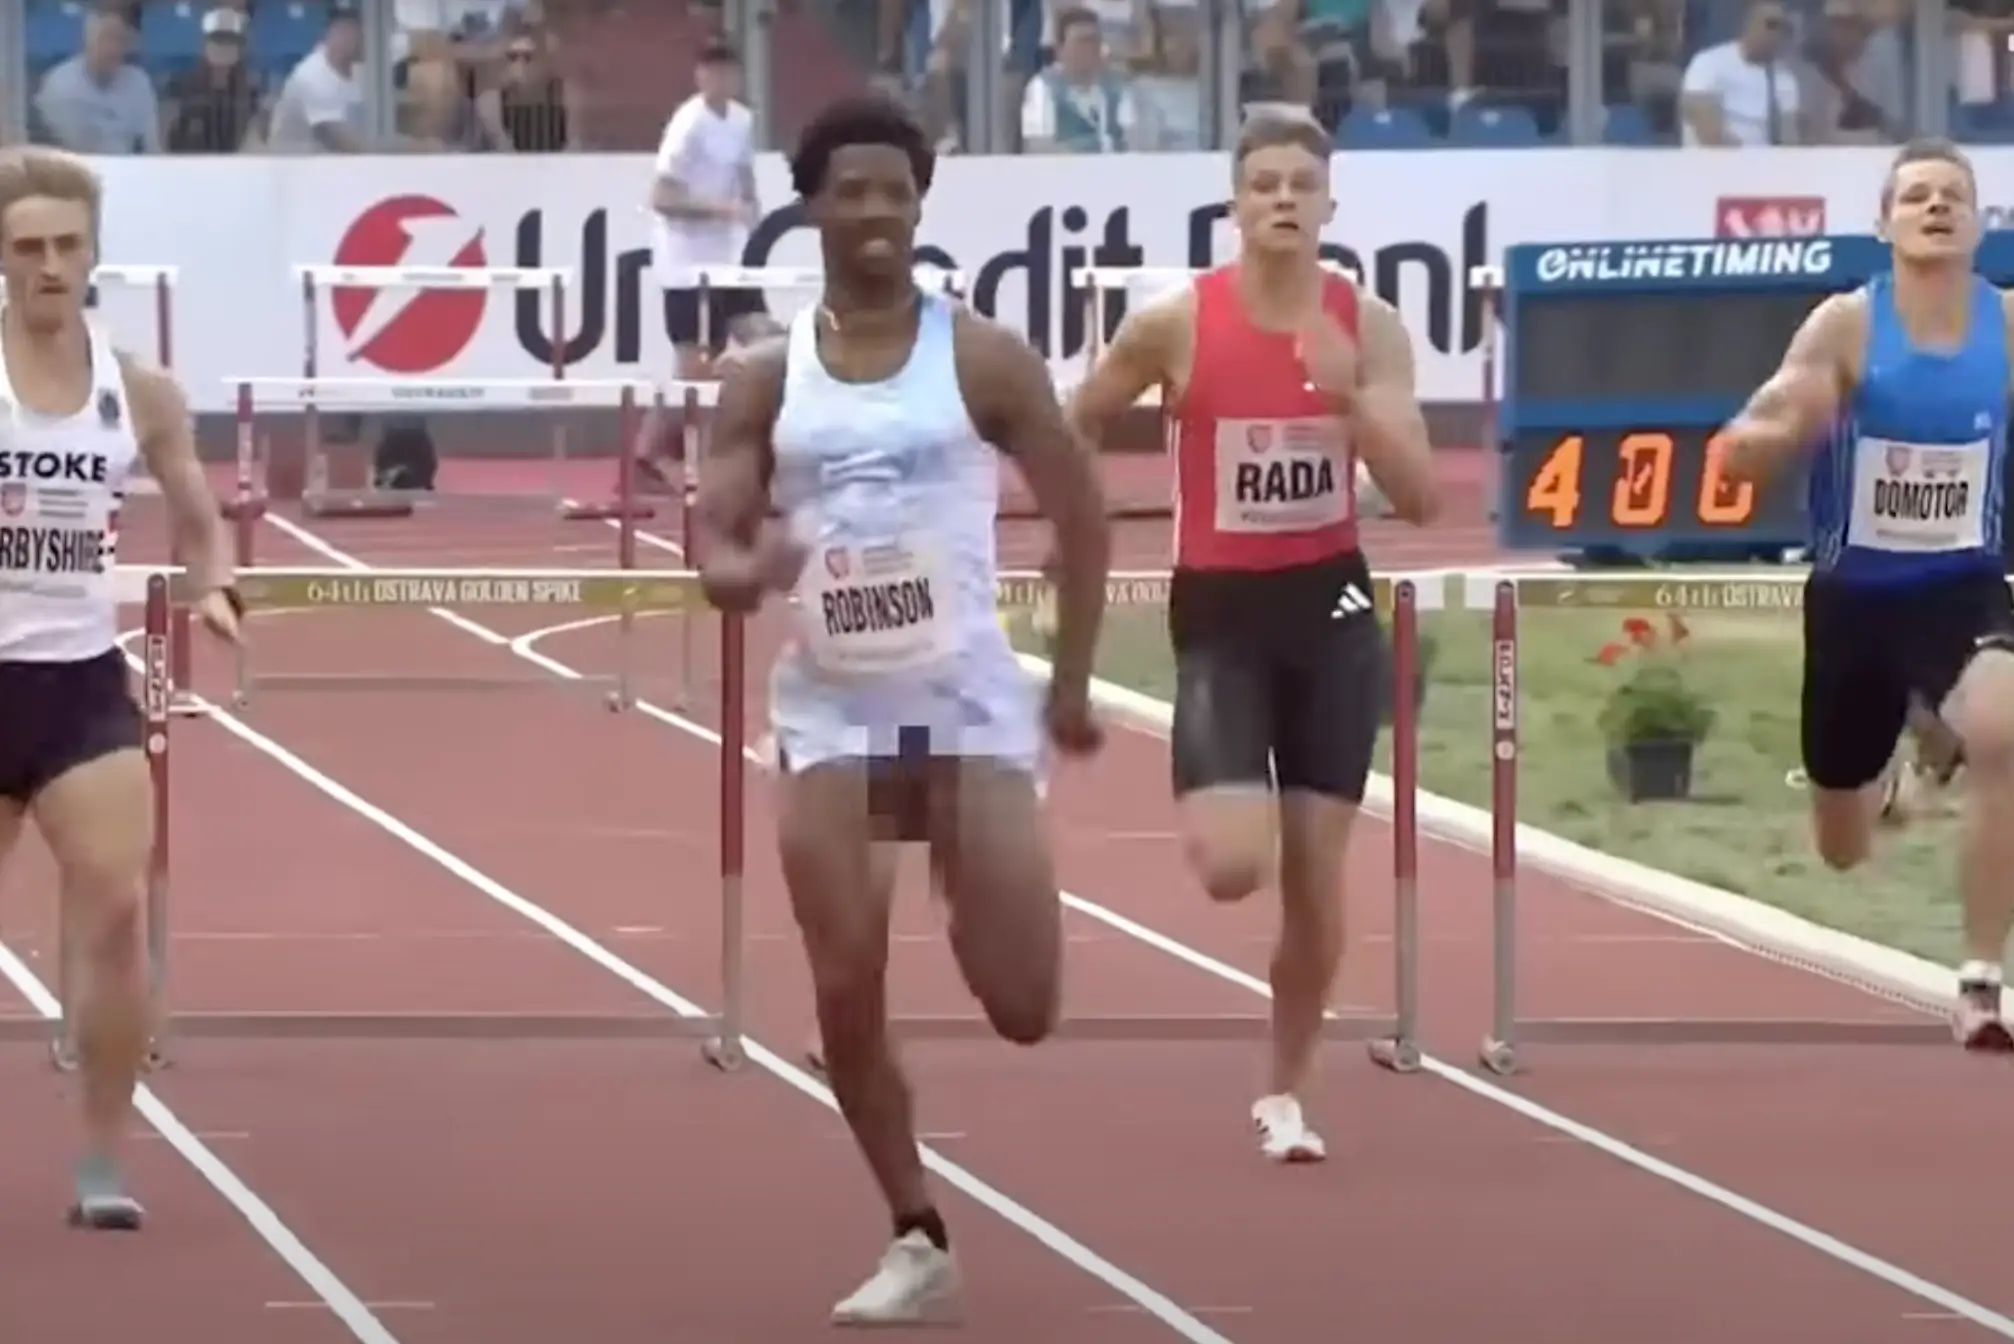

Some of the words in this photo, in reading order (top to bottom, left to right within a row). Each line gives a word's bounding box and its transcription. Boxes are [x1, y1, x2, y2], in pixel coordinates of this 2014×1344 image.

[1536, 241, 1832, 281] ONLINETIMING
[1236, 457, 1333, 503] RADA
[1874, 478, 1968, 520] DOMOTOR
[374, 579, 456, 602] OSTRAVA
[822, 576, 933, 636] ROBINSON
